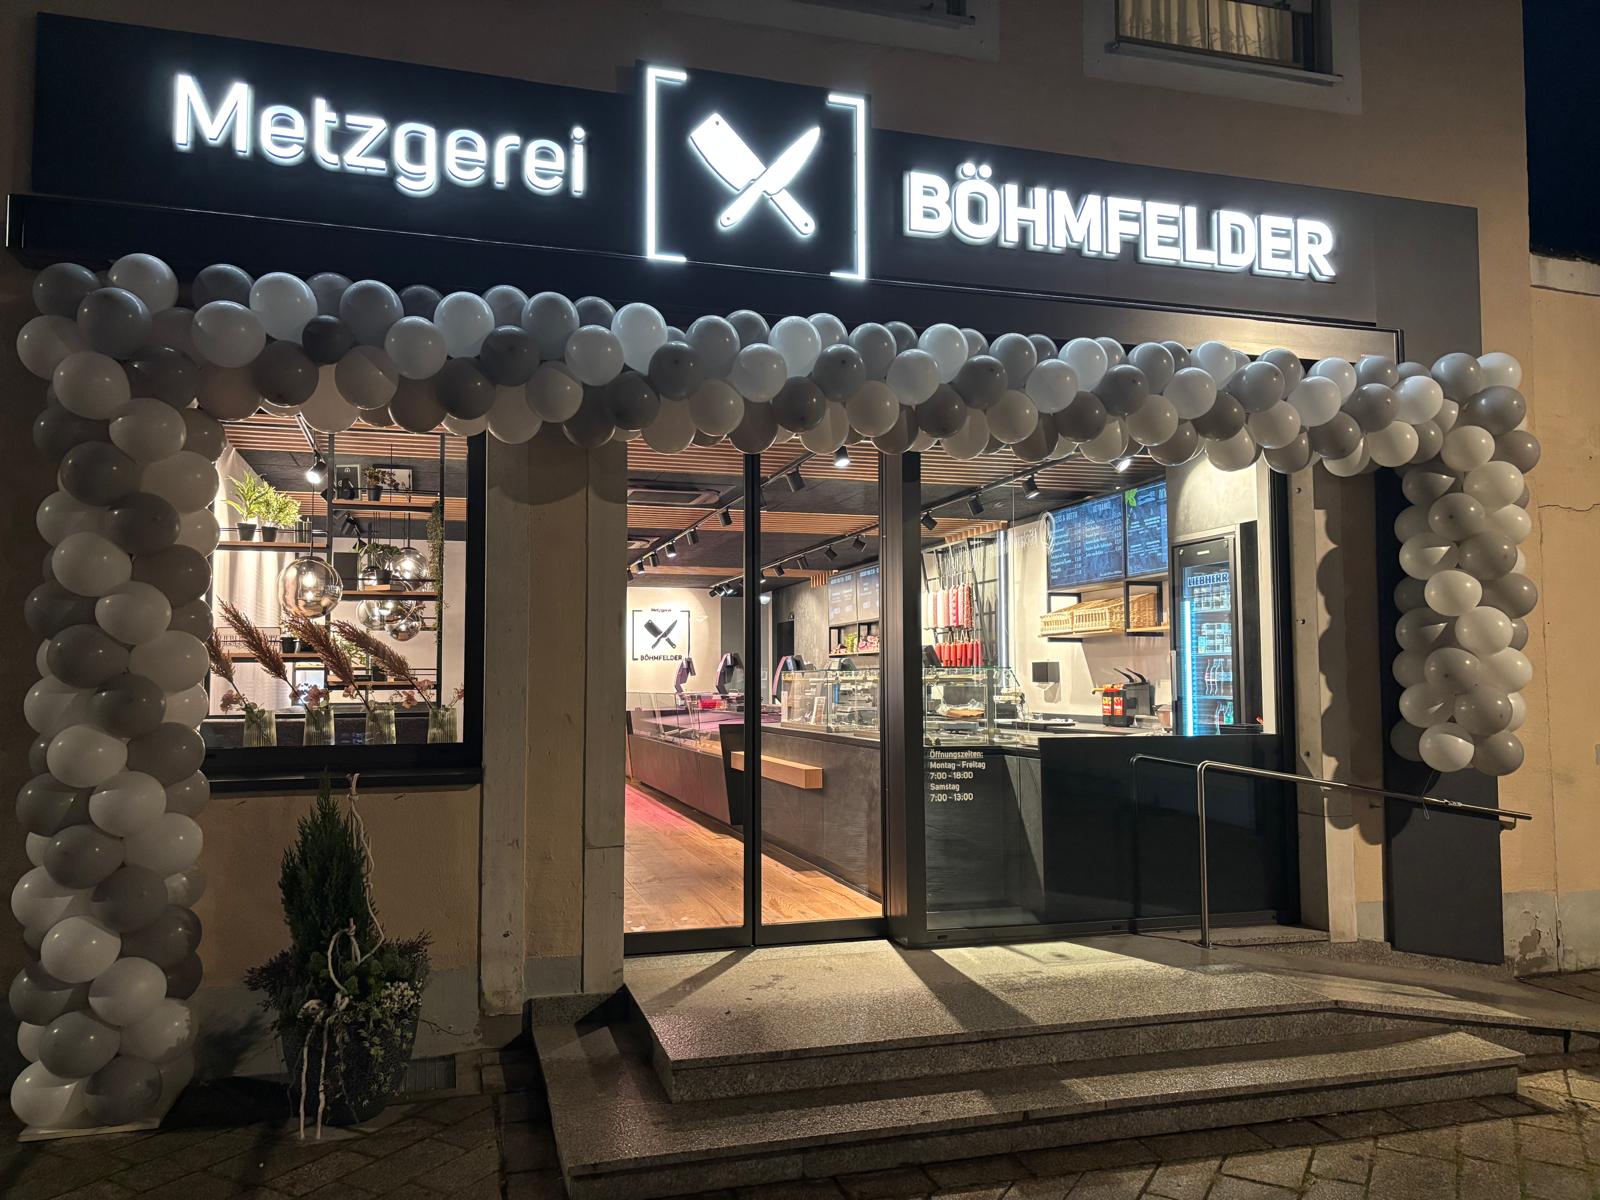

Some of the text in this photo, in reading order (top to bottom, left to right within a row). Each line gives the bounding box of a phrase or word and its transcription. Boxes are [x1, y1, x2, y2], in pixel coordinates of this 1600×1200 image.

[172, 72, 589, 197] Metzgerei
[903, 162, 1336, 282] BÖHMFELDER
[1188, 572, 1229, 587] LIEBHERR
[930, 749, 984, 759] Öffnungszeiten:
[930, 762, 956, 770] Montag
[961, 760, 986, 770] Freitag
[929, 772, 947, 780] 7:00
[953, 771, 974, 779] 18:00
[930, 783, 960, 791] Samstag
[930, 794, 948, 802] 7:00
[953, 793, 974, 801] 13:00
